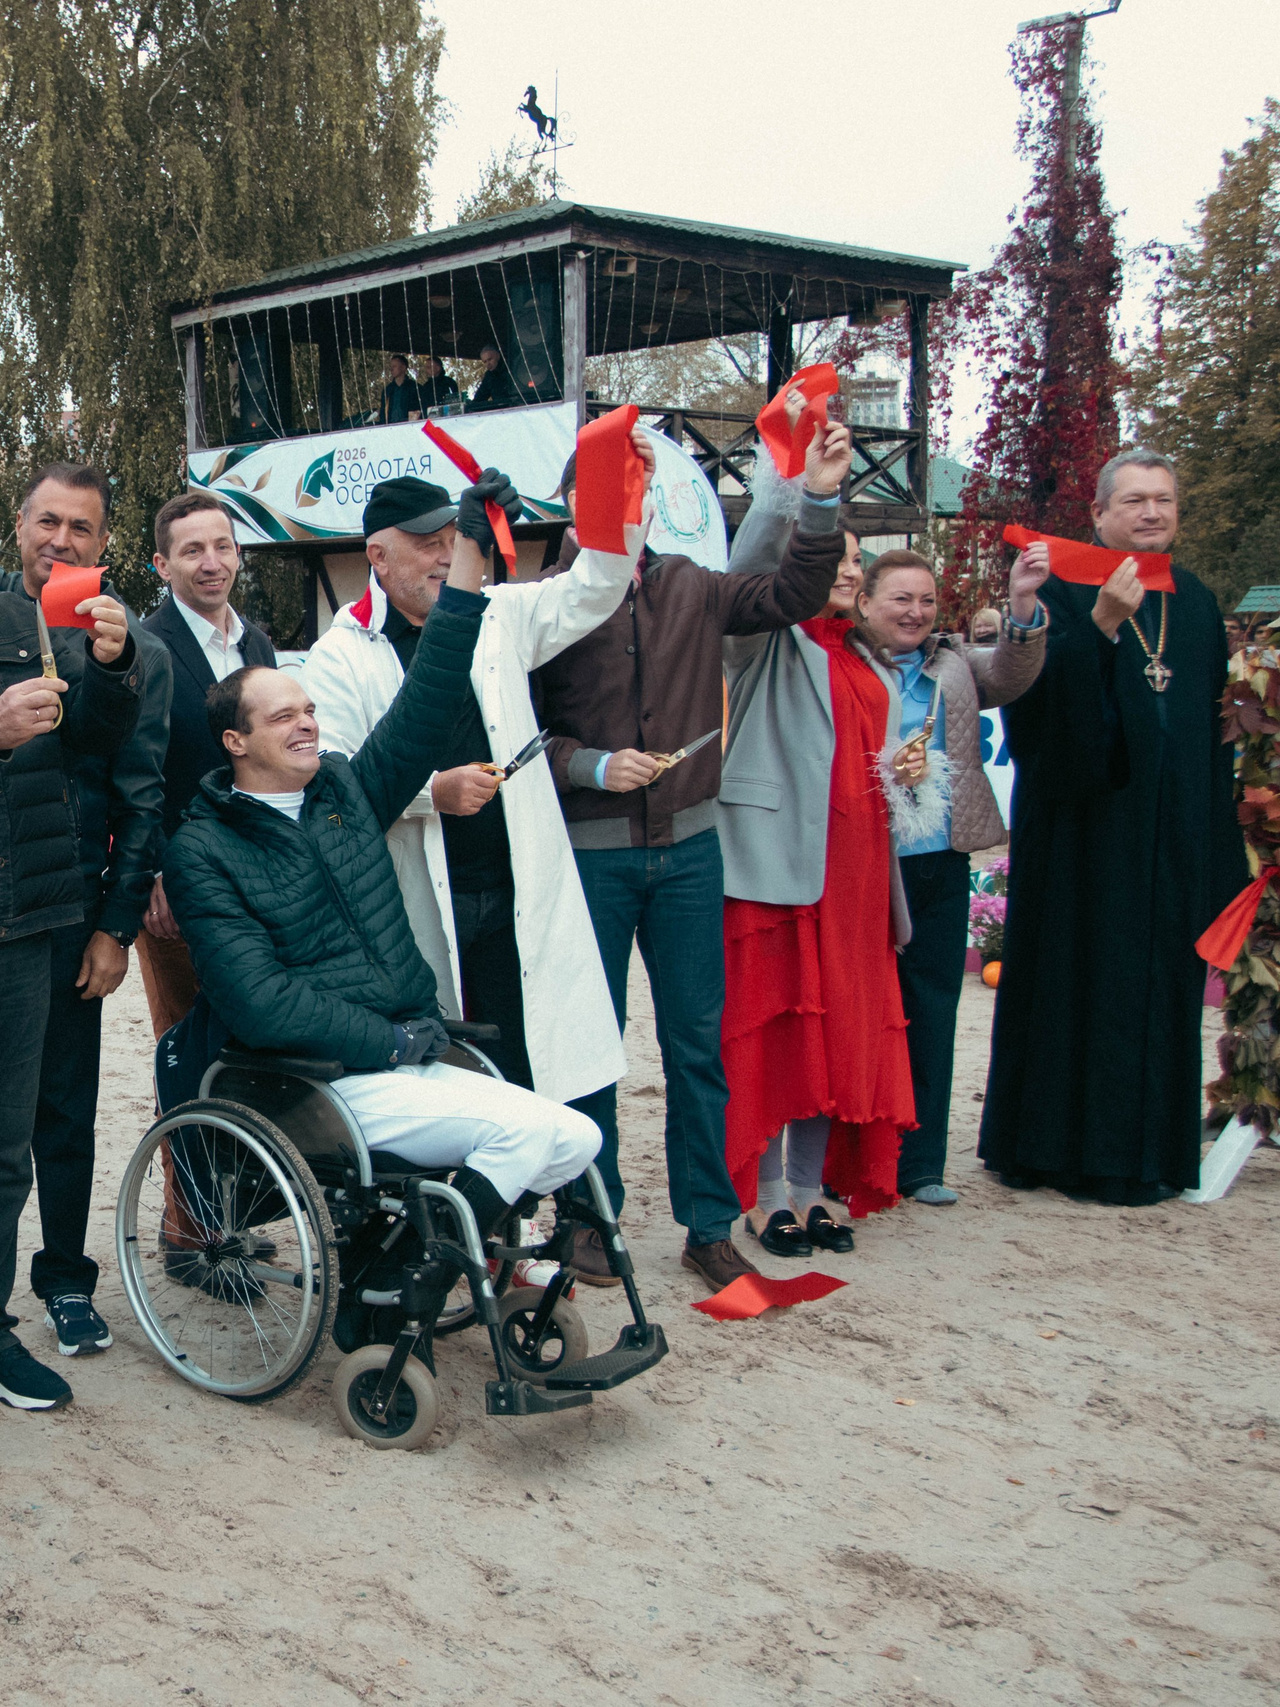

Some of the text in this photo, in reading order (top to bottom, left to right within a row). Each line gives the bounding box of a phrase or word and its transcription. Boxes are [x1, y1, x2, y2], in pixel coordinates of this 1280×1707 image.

[336, 447, 367, 462] 2026
[336, 454, 432, 484] ЗОЛОТАЯ
[335, 483, 375, 506] ОСЕ
